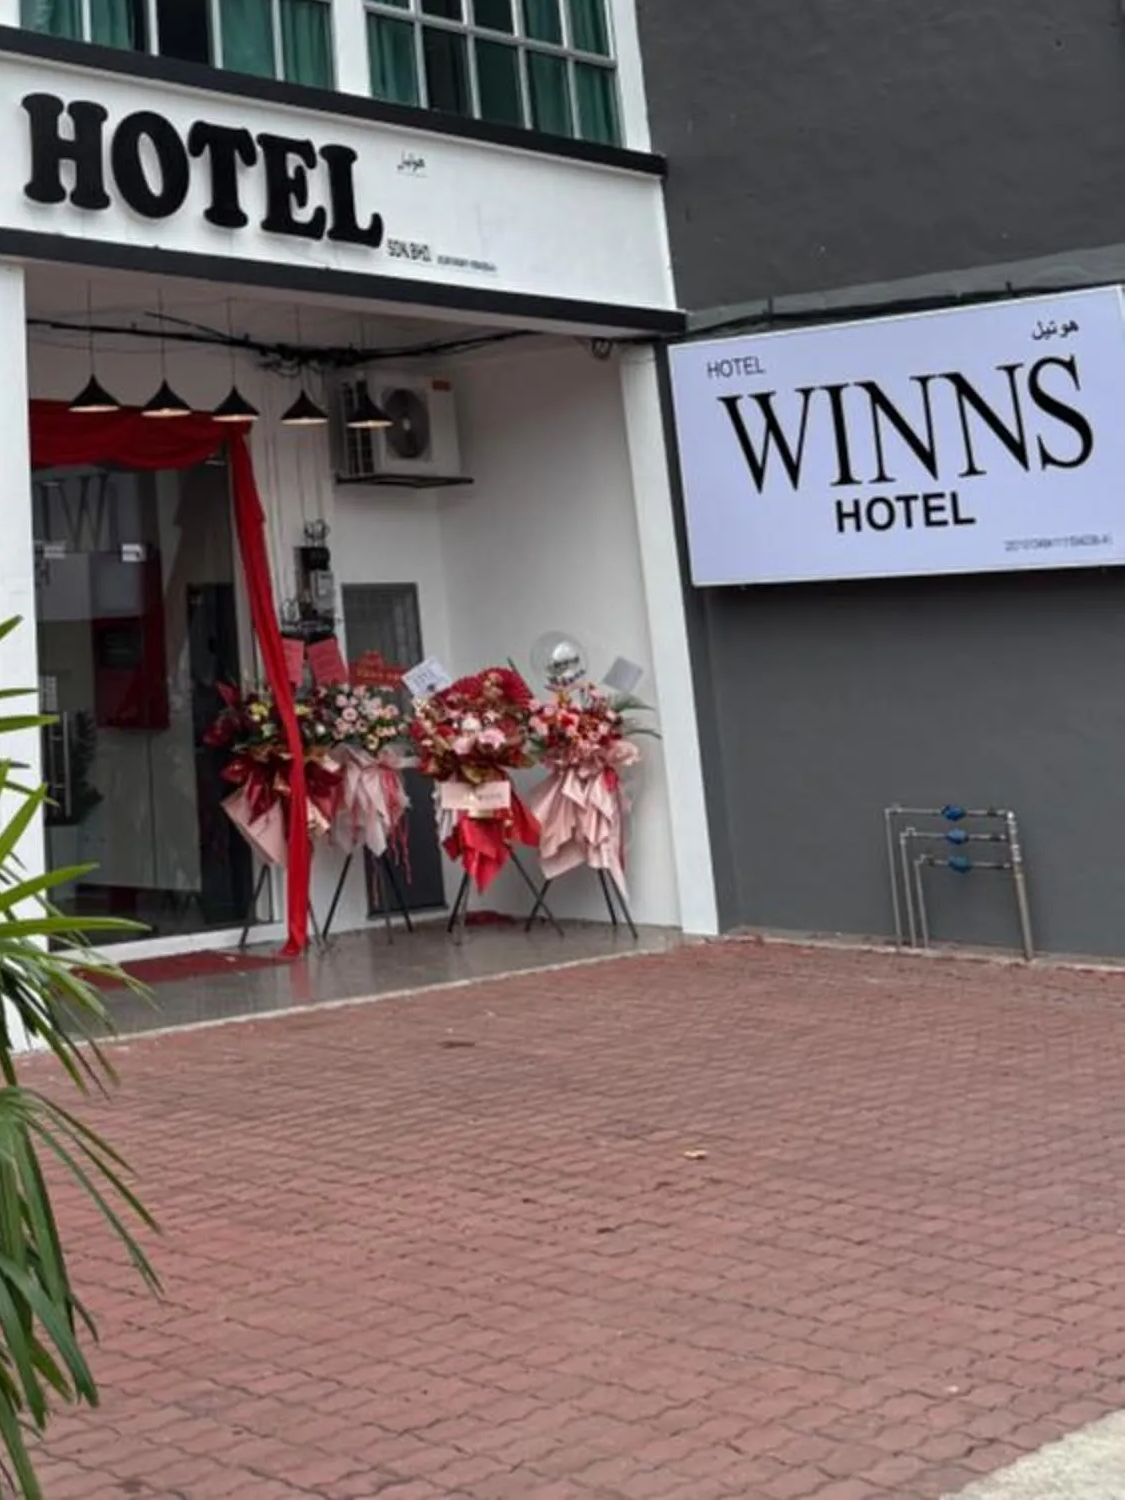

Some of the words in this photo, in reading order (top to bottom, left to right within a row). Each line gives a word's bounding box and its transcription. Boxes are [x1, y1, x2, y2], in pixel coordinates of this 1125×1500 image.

[21, 92, 385, 250] HOTEL
[1031, 319, 1079, 341] هوتيل
[706, 355, 766, 379] HOTEL
[717, 354, 1094, 495] WINNS
[835, 490, 977, 533] HOTEL
